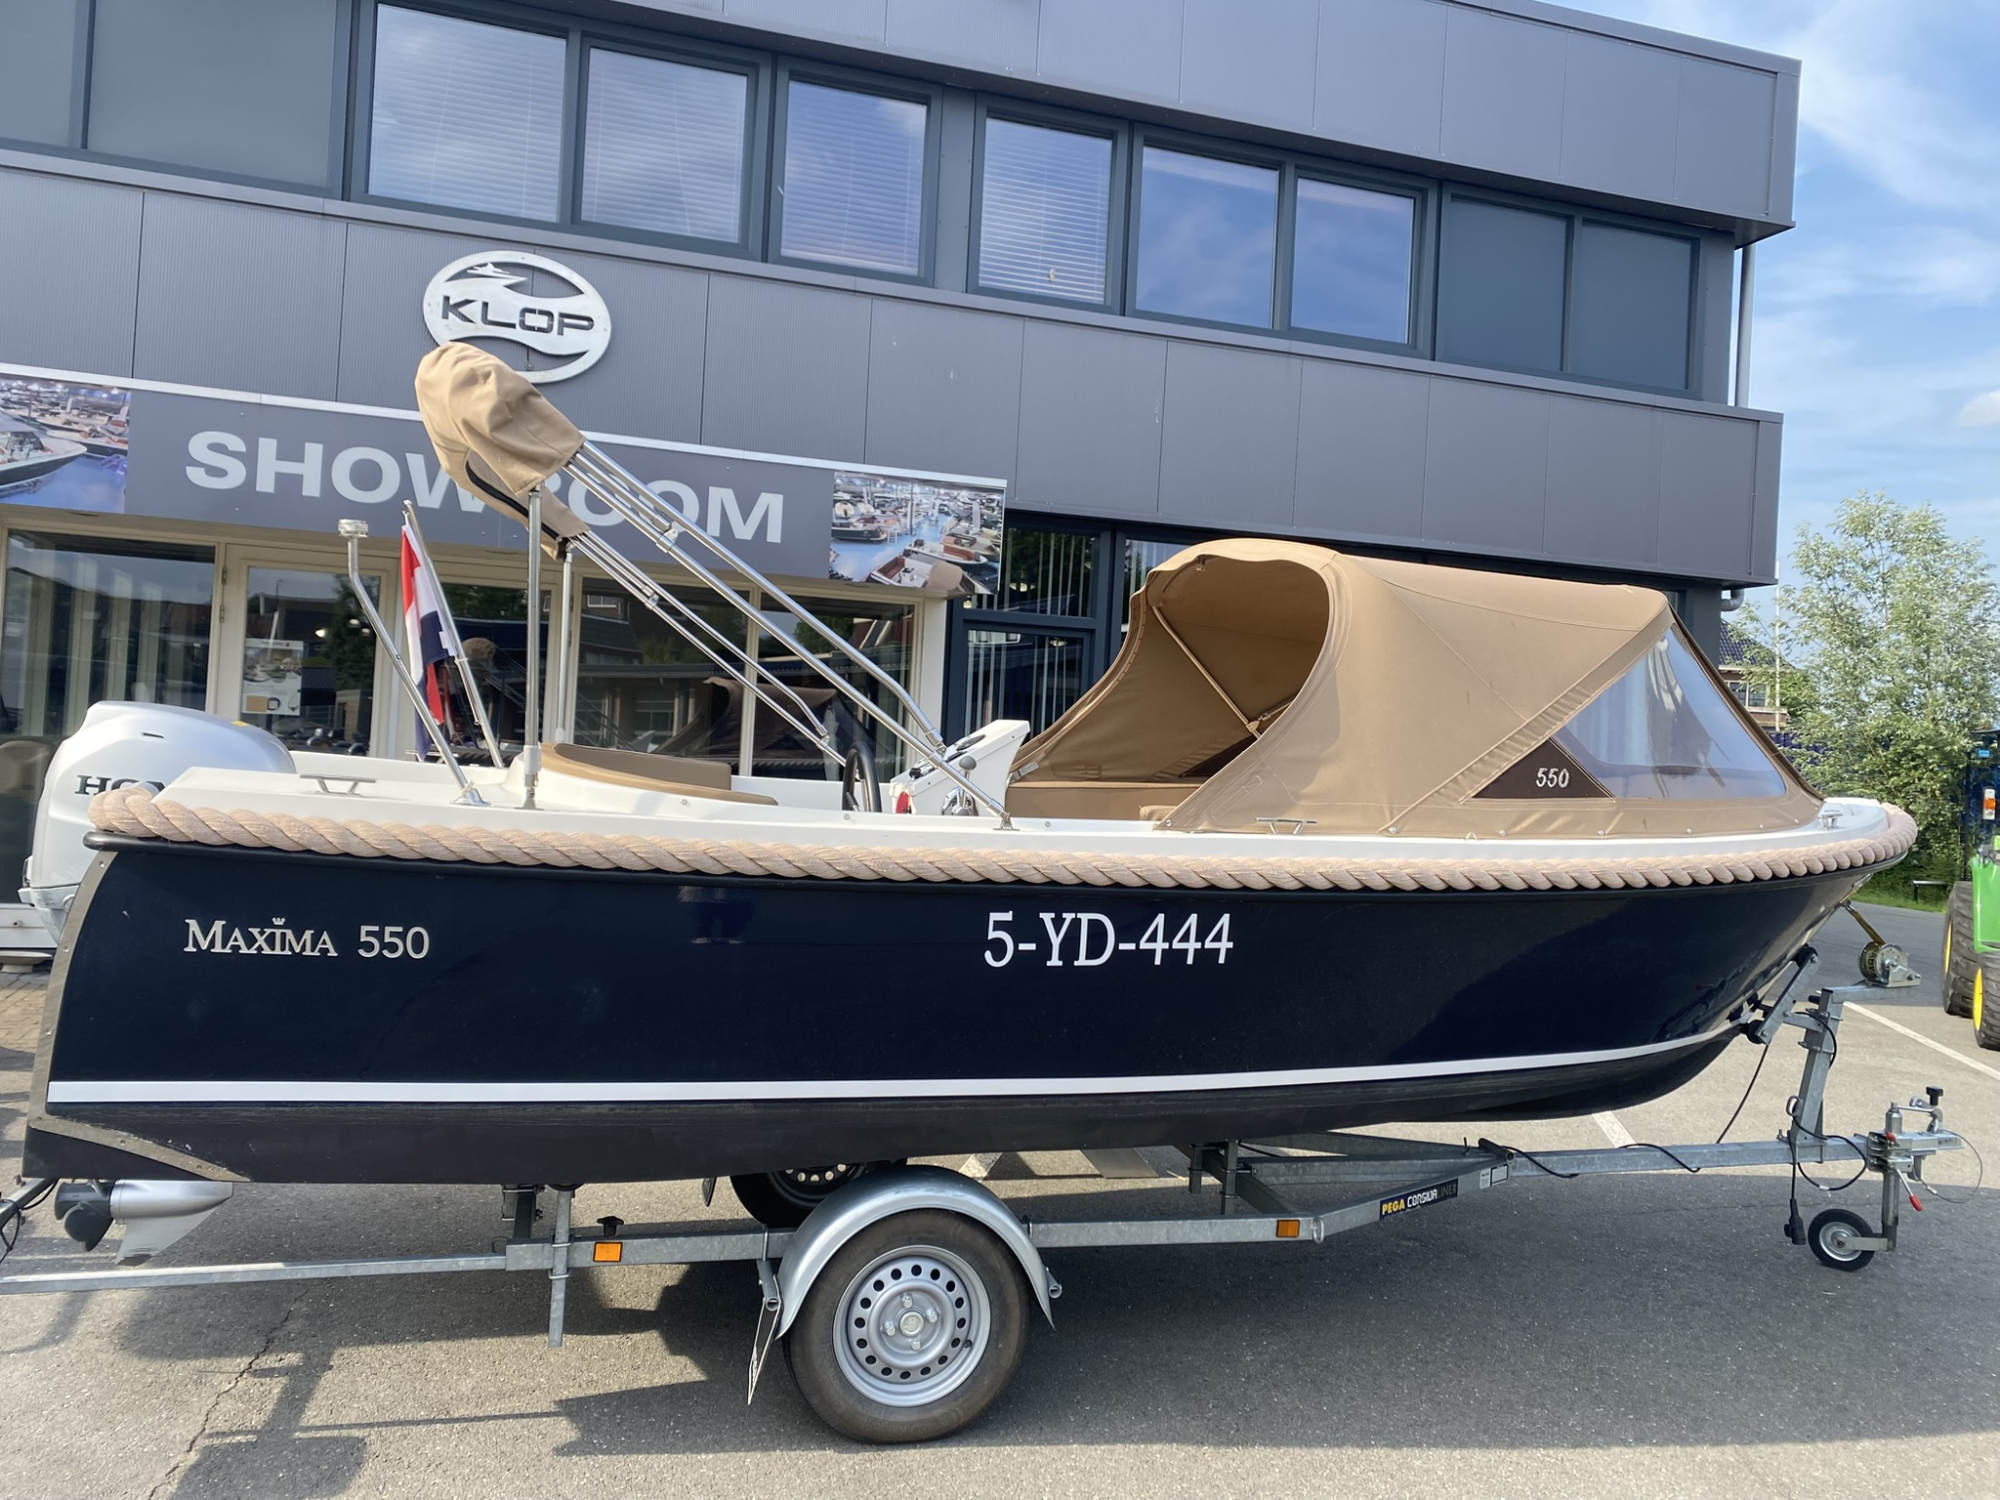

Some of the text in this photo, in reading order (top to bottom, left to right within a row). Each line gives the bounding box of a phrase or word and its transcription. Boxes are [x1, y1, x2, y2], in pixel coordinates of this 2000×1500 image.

[441, 295, 595, 336] KLOP
[185, 430, 784, 544] SHOWOOM
[1536, 767, 1570, 788] 550
[183, 918, 430, 959] MAXIMA 550
[984, 910, 1234, 968] 5-YD-444
[1382, 1199, 1406, 1215] PEGA
